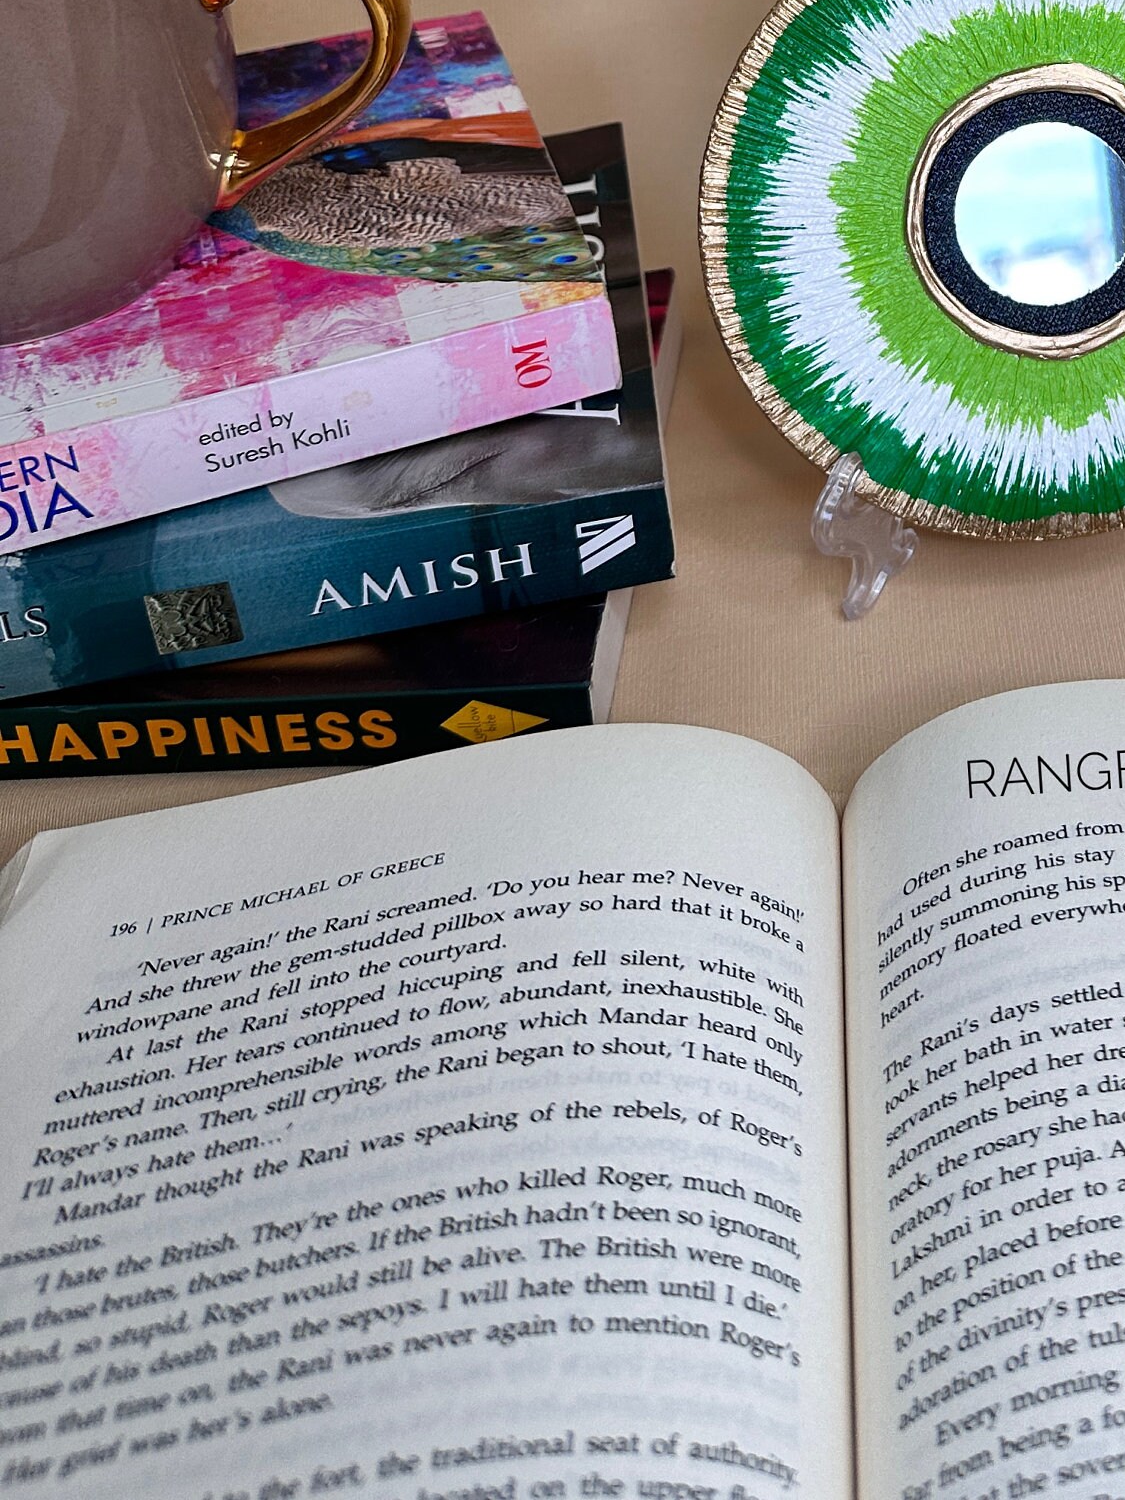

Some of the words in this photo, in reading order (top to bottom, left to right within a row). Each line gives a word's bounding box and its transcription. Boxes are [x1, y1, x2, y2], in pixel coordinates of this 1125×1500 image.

[511, 338, 552, 388] OM
[199, 413, 262, 445] edited
[268, 410, 294, 429] by
[205, 437, 284, 472] Suresh
[292, 419, 351, 449] Kohli
[308, 542, 539, 616] AMISH
[0, 710, 398, 763] HAPPINESS
[110, 921, 137, 937] 196
[161, 902, 233, 928] PRINCE
[240, 880, 330, 911] MICHAEL
[337, 871, 363, 887] OF
[370, 852, 445, 879] GREECE
[903, 863, 951, 896] Often
[956, 848, 987, 868] she
[993, 825, 1070, 855] roamed
[1075, 822, 1125, 837] from
[286, 926, 317, 943] the
[322, 910, 370, 934] Rani
[376, 887, 477, 922] screamed.
[529, 876, 570, 896] you
[577, 870, 625, 885] hear
[632, 870, 675, 884] me?
[682, 871, 744, 897] Never
[879, 924, 934, 973] silently
[940, 884, 1060, 930] summoning
[1064, 875, 1096, 892] his
[77, 1004, 212, 1043] windowpane
[220, 988, 260, 1012] and
[267, 977, 301, 1001] fell
[308, 971, 350, 990] into
[359, 960, 391, 978] the
[399, 933, 506, 968] courtyard.
[84, 990, 132, 1015] And
[138, 985, 174, 1003] she
[182, 970, 242, 993] threw
[250, 960, 281, 978] the
[287, 922, 424, 973] gem-studded
[431, 911, 505, 940] pillbox
[513, 902, 572, 919] away
[579, 900, 603, 912] so
[611, 895, 662, 911] hard
[671, 897, 712, 916] that
[719, 904, 734, 921] it
[740, 909, 790, 943] broke
[796, 940, 804, 953] a
[880, 946, 946, 1001] memory
[954, 914, 1023, 952] floated
[106, 1045, 134, 1065] At
[145, 1035, 184, 1058] last
[196, 1026, 228, 1045] the
[239, 1008, 289, 1034] Rani
[300, 984, 385, 1020] stopped
[397, 965, 505, 997] hiccuping
[517, 953, 558, 974] and
[571, 950, 606, 967] fell
[620, 950, 685, 971] silent,
[698, 959, 756, 983] white
[766, 978, 804, 1008] with
[881, 988, 924, 1029] heart.
[43, 1097, 145, 1135] muttered
[152, 1053, 344, 1111] incomprehensible
[353, 1035, 421, 1063] words
[430, 1022, 508, 1047] among
[518, 1008, 588, 1031] which
[598, 1007, 689, 1027] Mandar
[697, 1012, 758, 1043] heard
[766, 1037, 803, 1067] only
[885, 1079, 921, 1115] took
[925, 1059, 957, 1086] her
[963, 1036, 1012, 1065] bath
[1019, 1030, 1043, 1046] in
[1049, 1018, 1114, 1038] water
[53, 1192, 147, 1226] Mandar
[154, 1167, 244, 1204] thought
[252, 1159, 289, 1180] the
[296, 1139, 351, 1170] Rani
[360, 1132, 405, 1154] was
[412, 1111, 520, 1148] speaking
[528, 1102, 557, 1124] of
[563, 1100, 603, 1121] the
[697, 1108, 722, 1128] of
[890, 1221, 973, 1281] Lakshmi
[979, 1210, 1004, 1229] in
[1009, 1187, 1076, 1217] order
[1082, 1181, 1110, 1198] to
